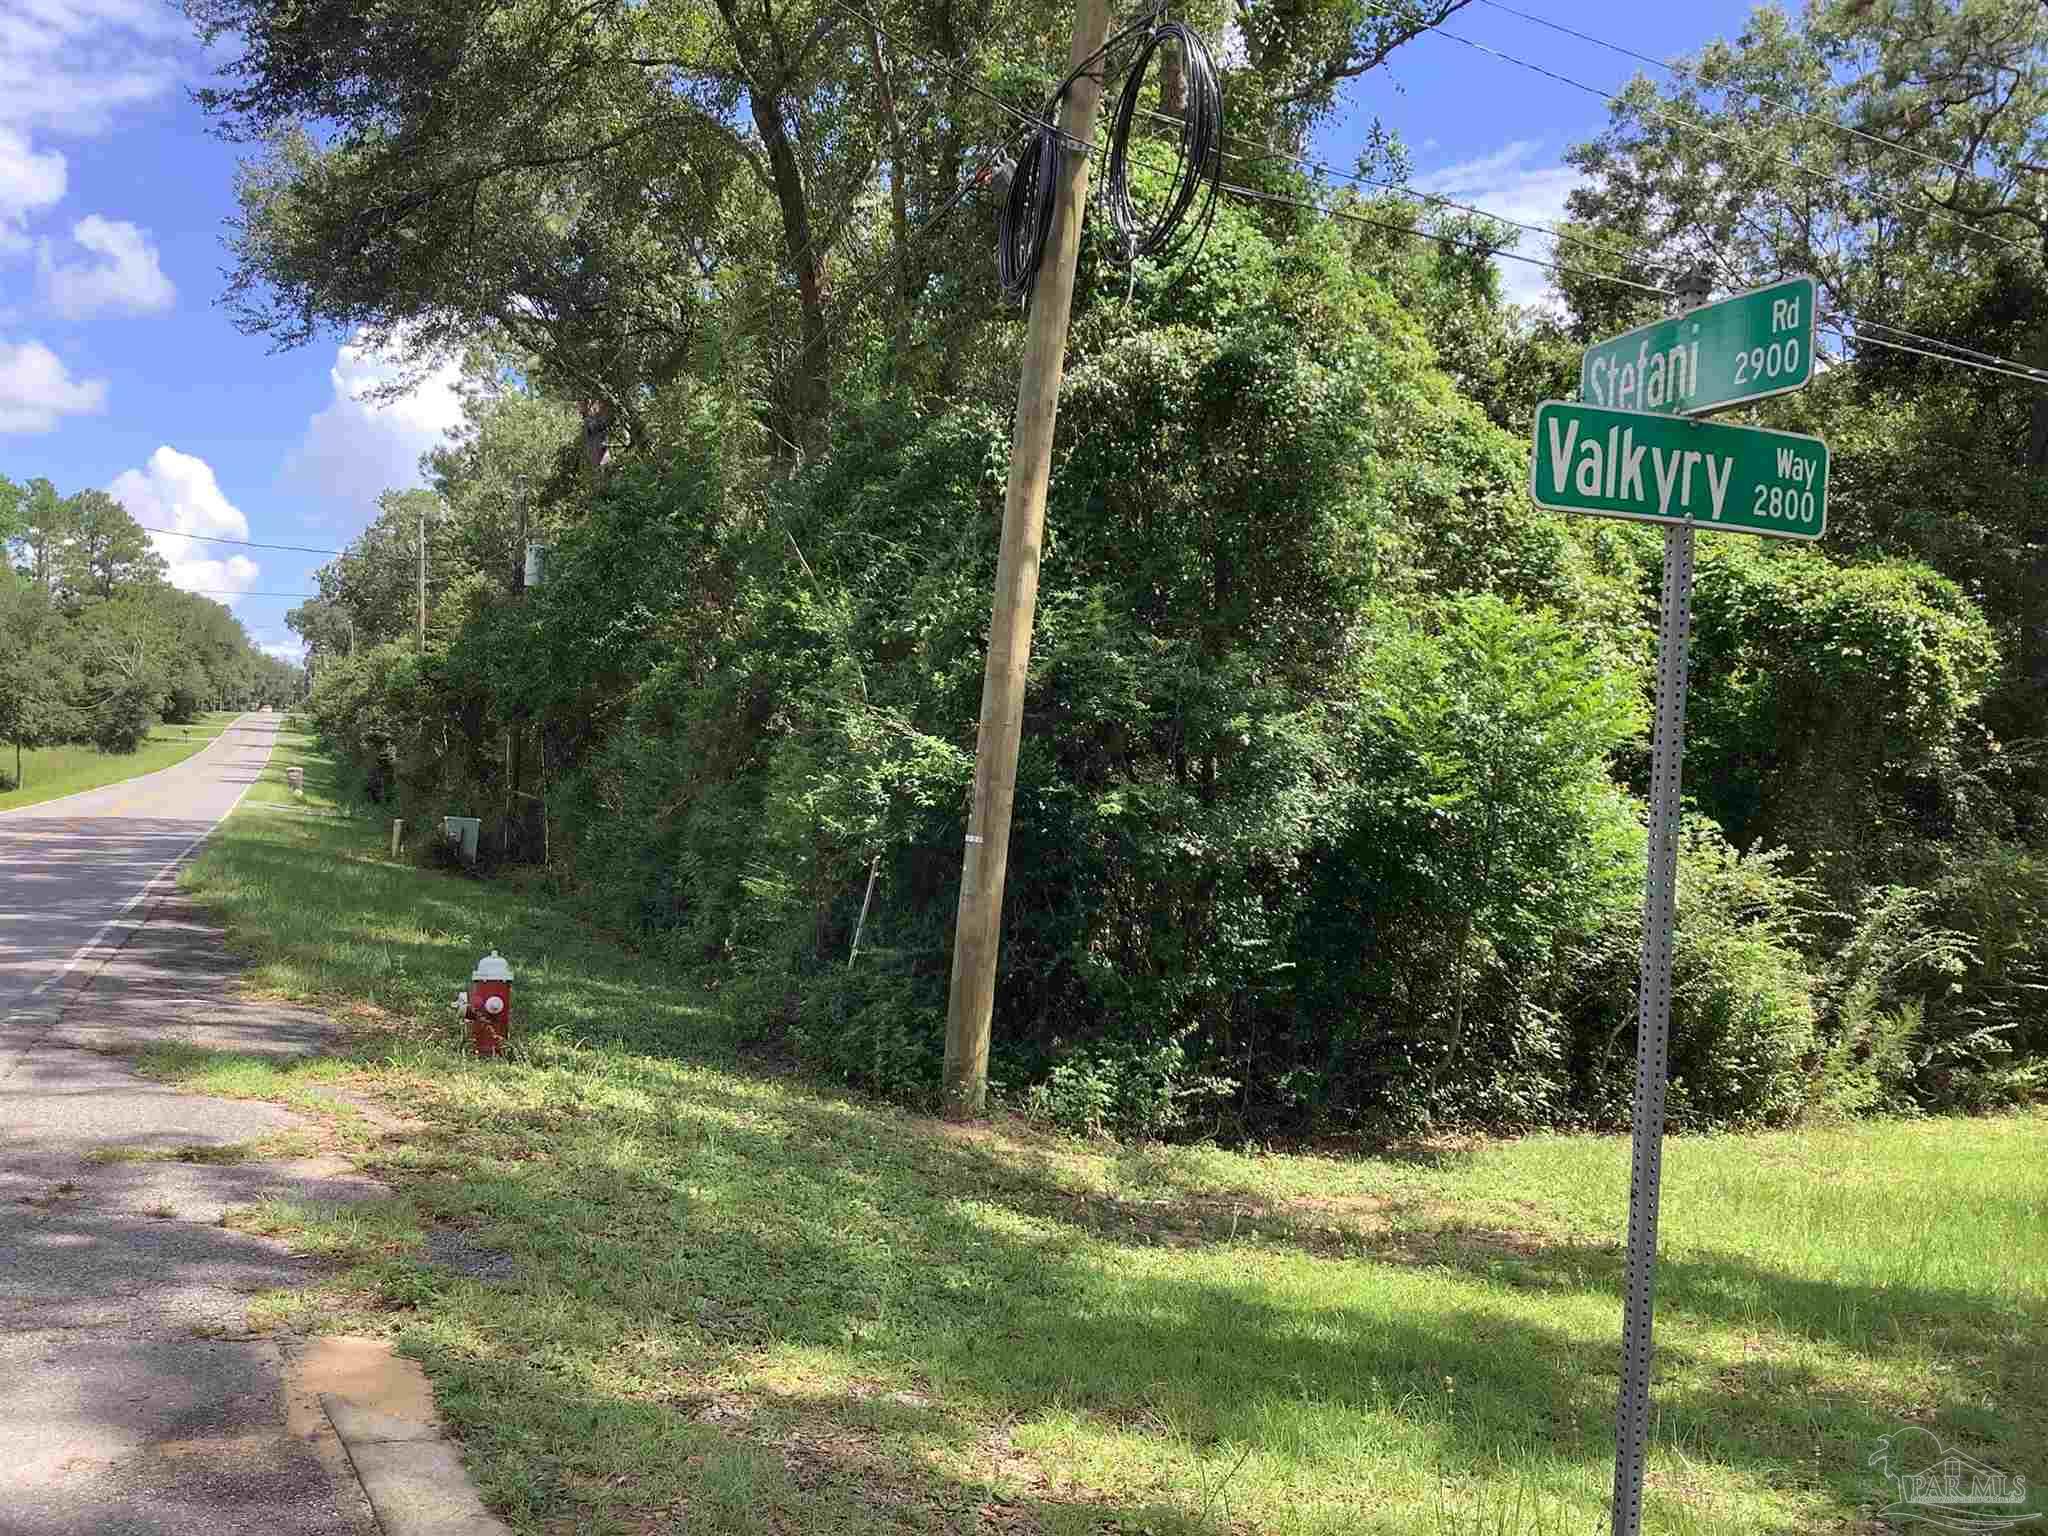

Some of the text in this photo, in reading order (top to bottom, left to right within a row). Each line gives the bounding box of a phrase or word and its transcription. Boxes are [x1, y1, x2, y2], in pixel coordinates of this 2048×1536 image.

[1772, 296, 1799, 333] Rd
[1590, 323, 1700, 411] Stefani
[1734, 338, 1799, 386] 2900
[1548, 416, 1734, 520] Valkyry
[1776, 447, 1817, 490] Way
[1753, 484, 1814, 523] 2800
